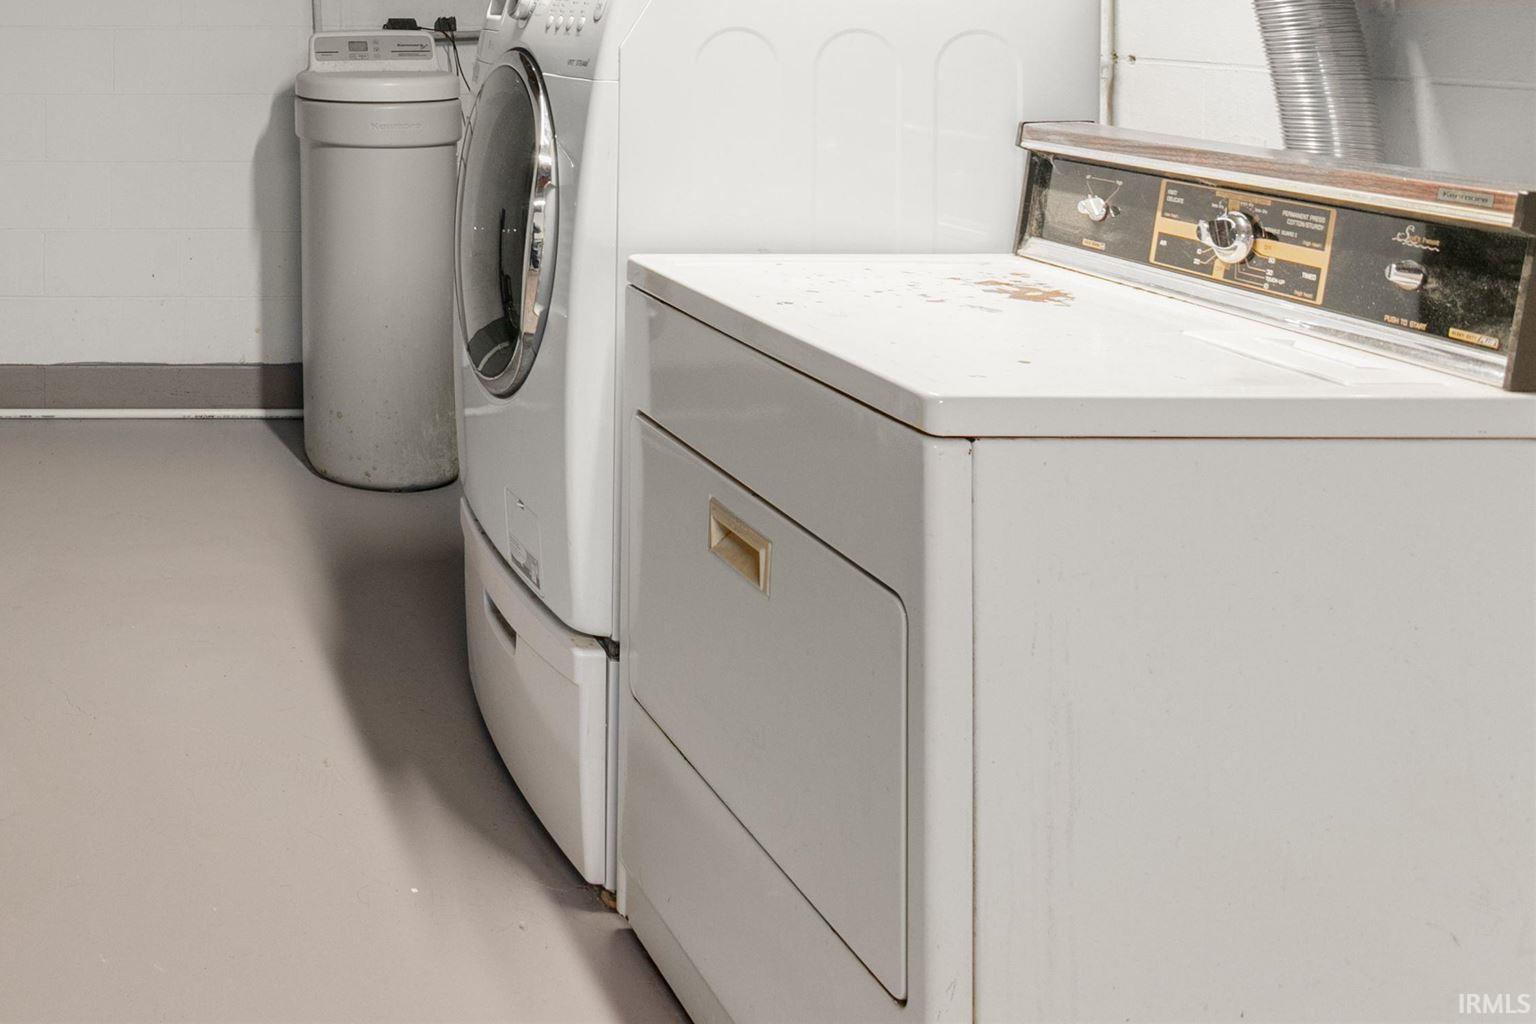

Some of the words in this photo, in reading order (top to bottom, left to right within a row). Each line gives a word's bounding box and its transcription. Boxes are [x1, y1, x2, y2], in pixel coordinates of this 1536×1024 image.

[1384, 314, 1399, 325] PUSH
[1400, 318, 1408, 326] TO
[1409, 320, 1428, 330] START
